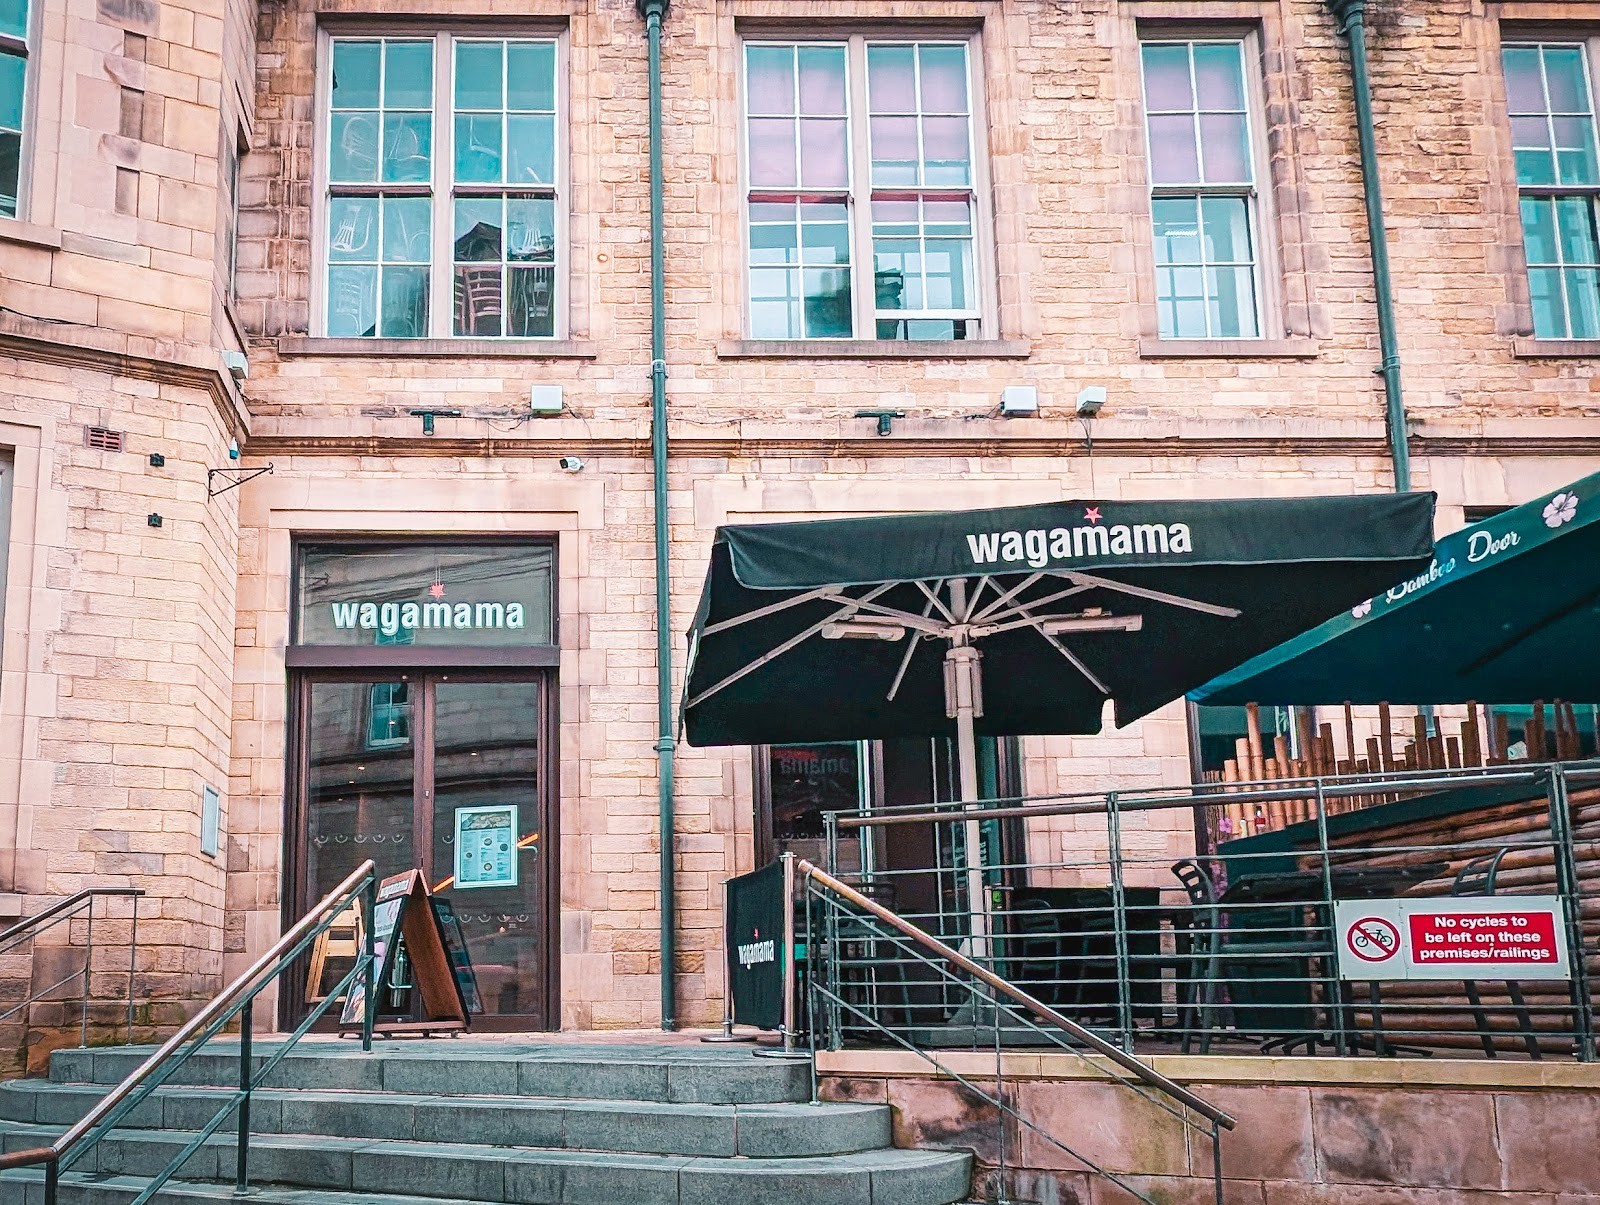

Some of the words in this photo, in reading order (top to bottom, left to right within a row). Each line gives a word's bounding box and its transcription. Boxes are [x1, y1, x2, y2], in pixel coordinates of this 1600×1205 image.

[966, 523, 1193, 568] wagamama
[1467, 530, 1521, 563] Door
[331, 601, 525, 636] wagamama
[1425, 933, 1444, 943] be
[1447, 932, 1472, 942] left
[1475, 933, 1494, 942] on
[1498, 931, 1541, 942] these
[1435, 917, 1456, 927] No
[1460, 917, 1508, 929] cycles
[1511, 917, 1527, 927] to
[738, 940, 775, 970] wagamama
[1420, 947, 1550, 960] premises/railings
